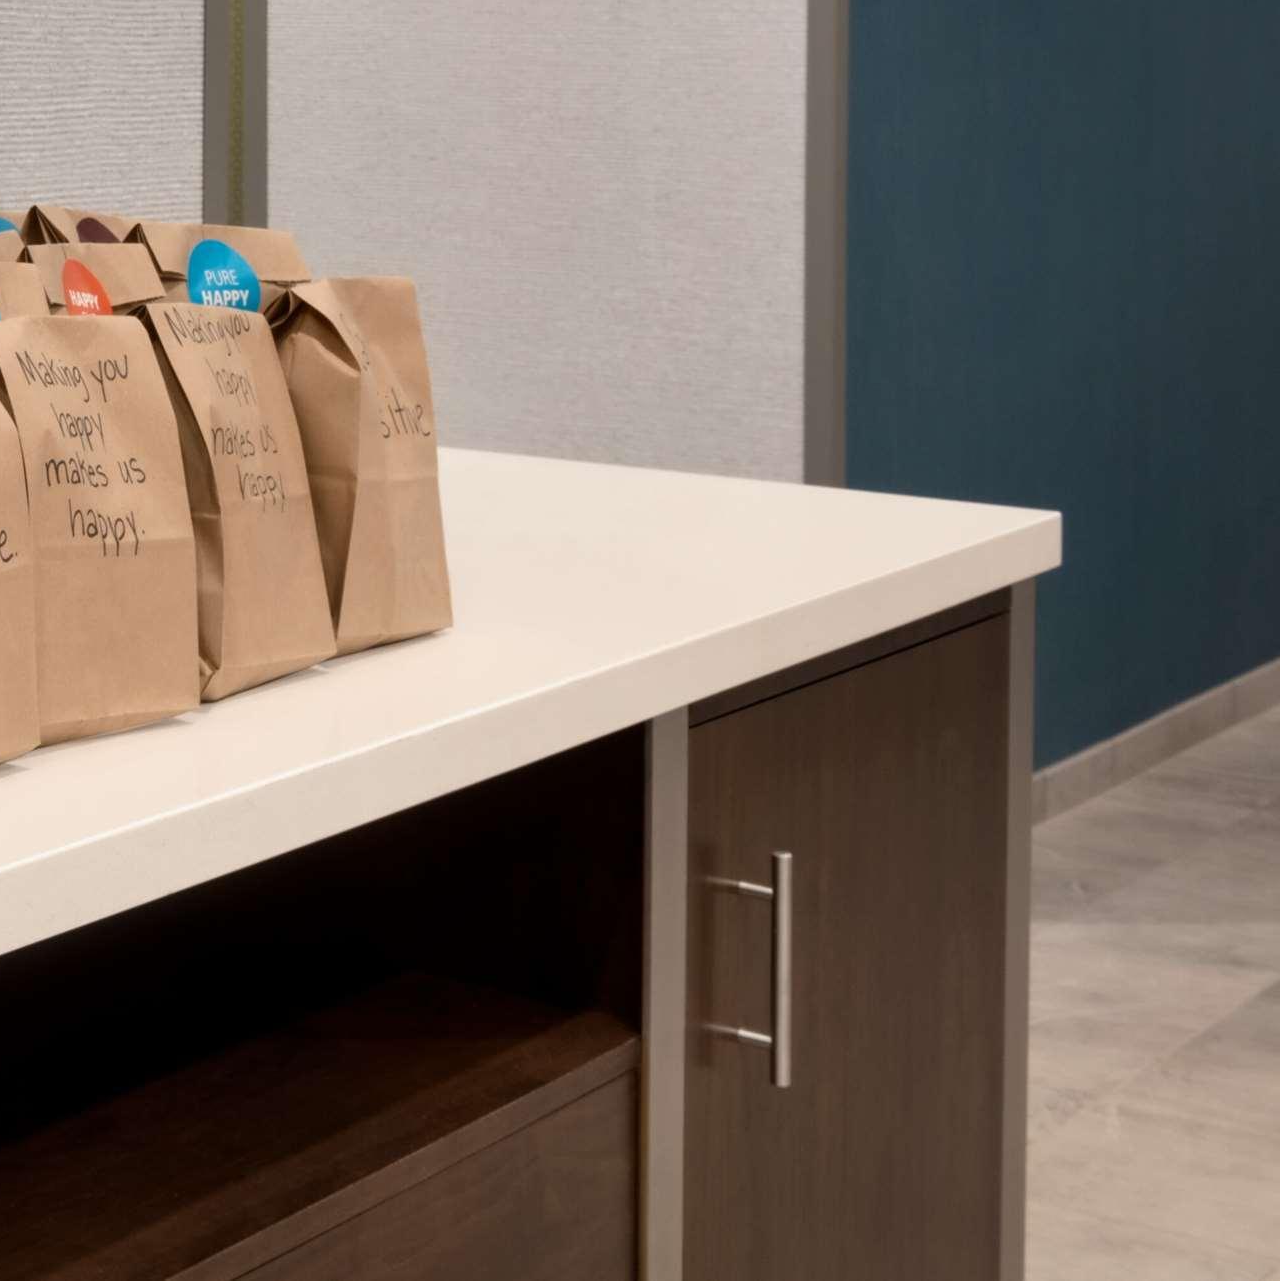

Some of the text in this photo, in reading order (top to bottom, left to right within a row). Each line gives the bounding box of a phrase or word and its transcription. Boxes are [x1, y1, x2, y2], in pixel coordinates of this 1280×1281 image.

[204, 270, 240, 287] PURE
[69, 289, 101, 310] HAPPY
[201, 289, 250, 307] HAPPY
[15, 349, 130, 403] Making you
[49, 402, 106, 452] happy
[44, 451, 147, 488] makes us
[68, 497, 146, 558] happy.
